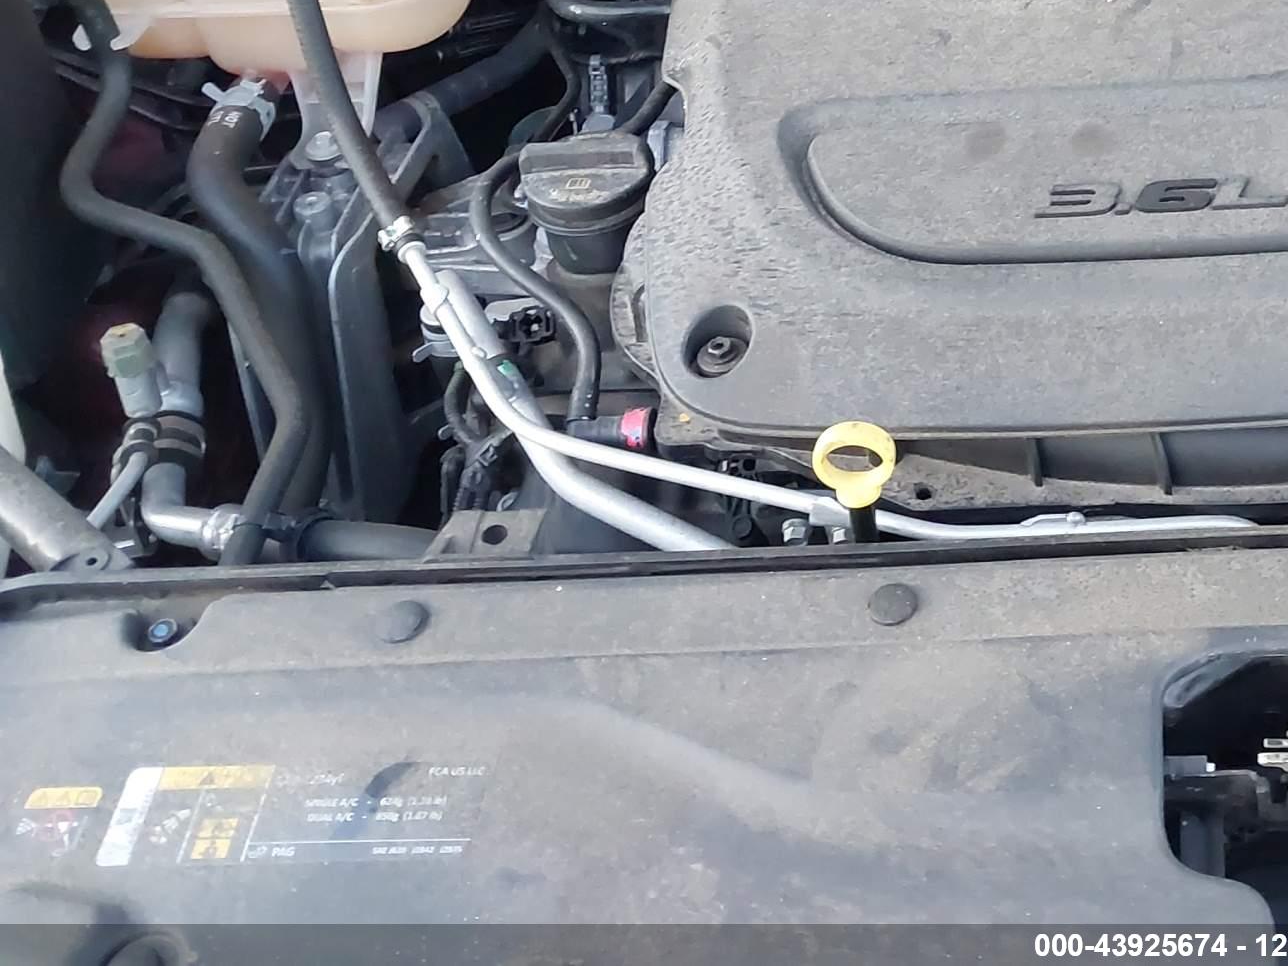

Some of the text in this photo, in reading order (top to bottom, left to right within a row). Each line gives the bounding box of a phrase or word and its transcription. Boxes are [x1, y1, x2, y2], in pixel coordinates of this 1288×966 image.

[428, 766, 450, 778] FCA
[339, 797, 359, 808] A/C
[335, 812, 355, 823] A/C
[271, 846, 296, 857] PAG
